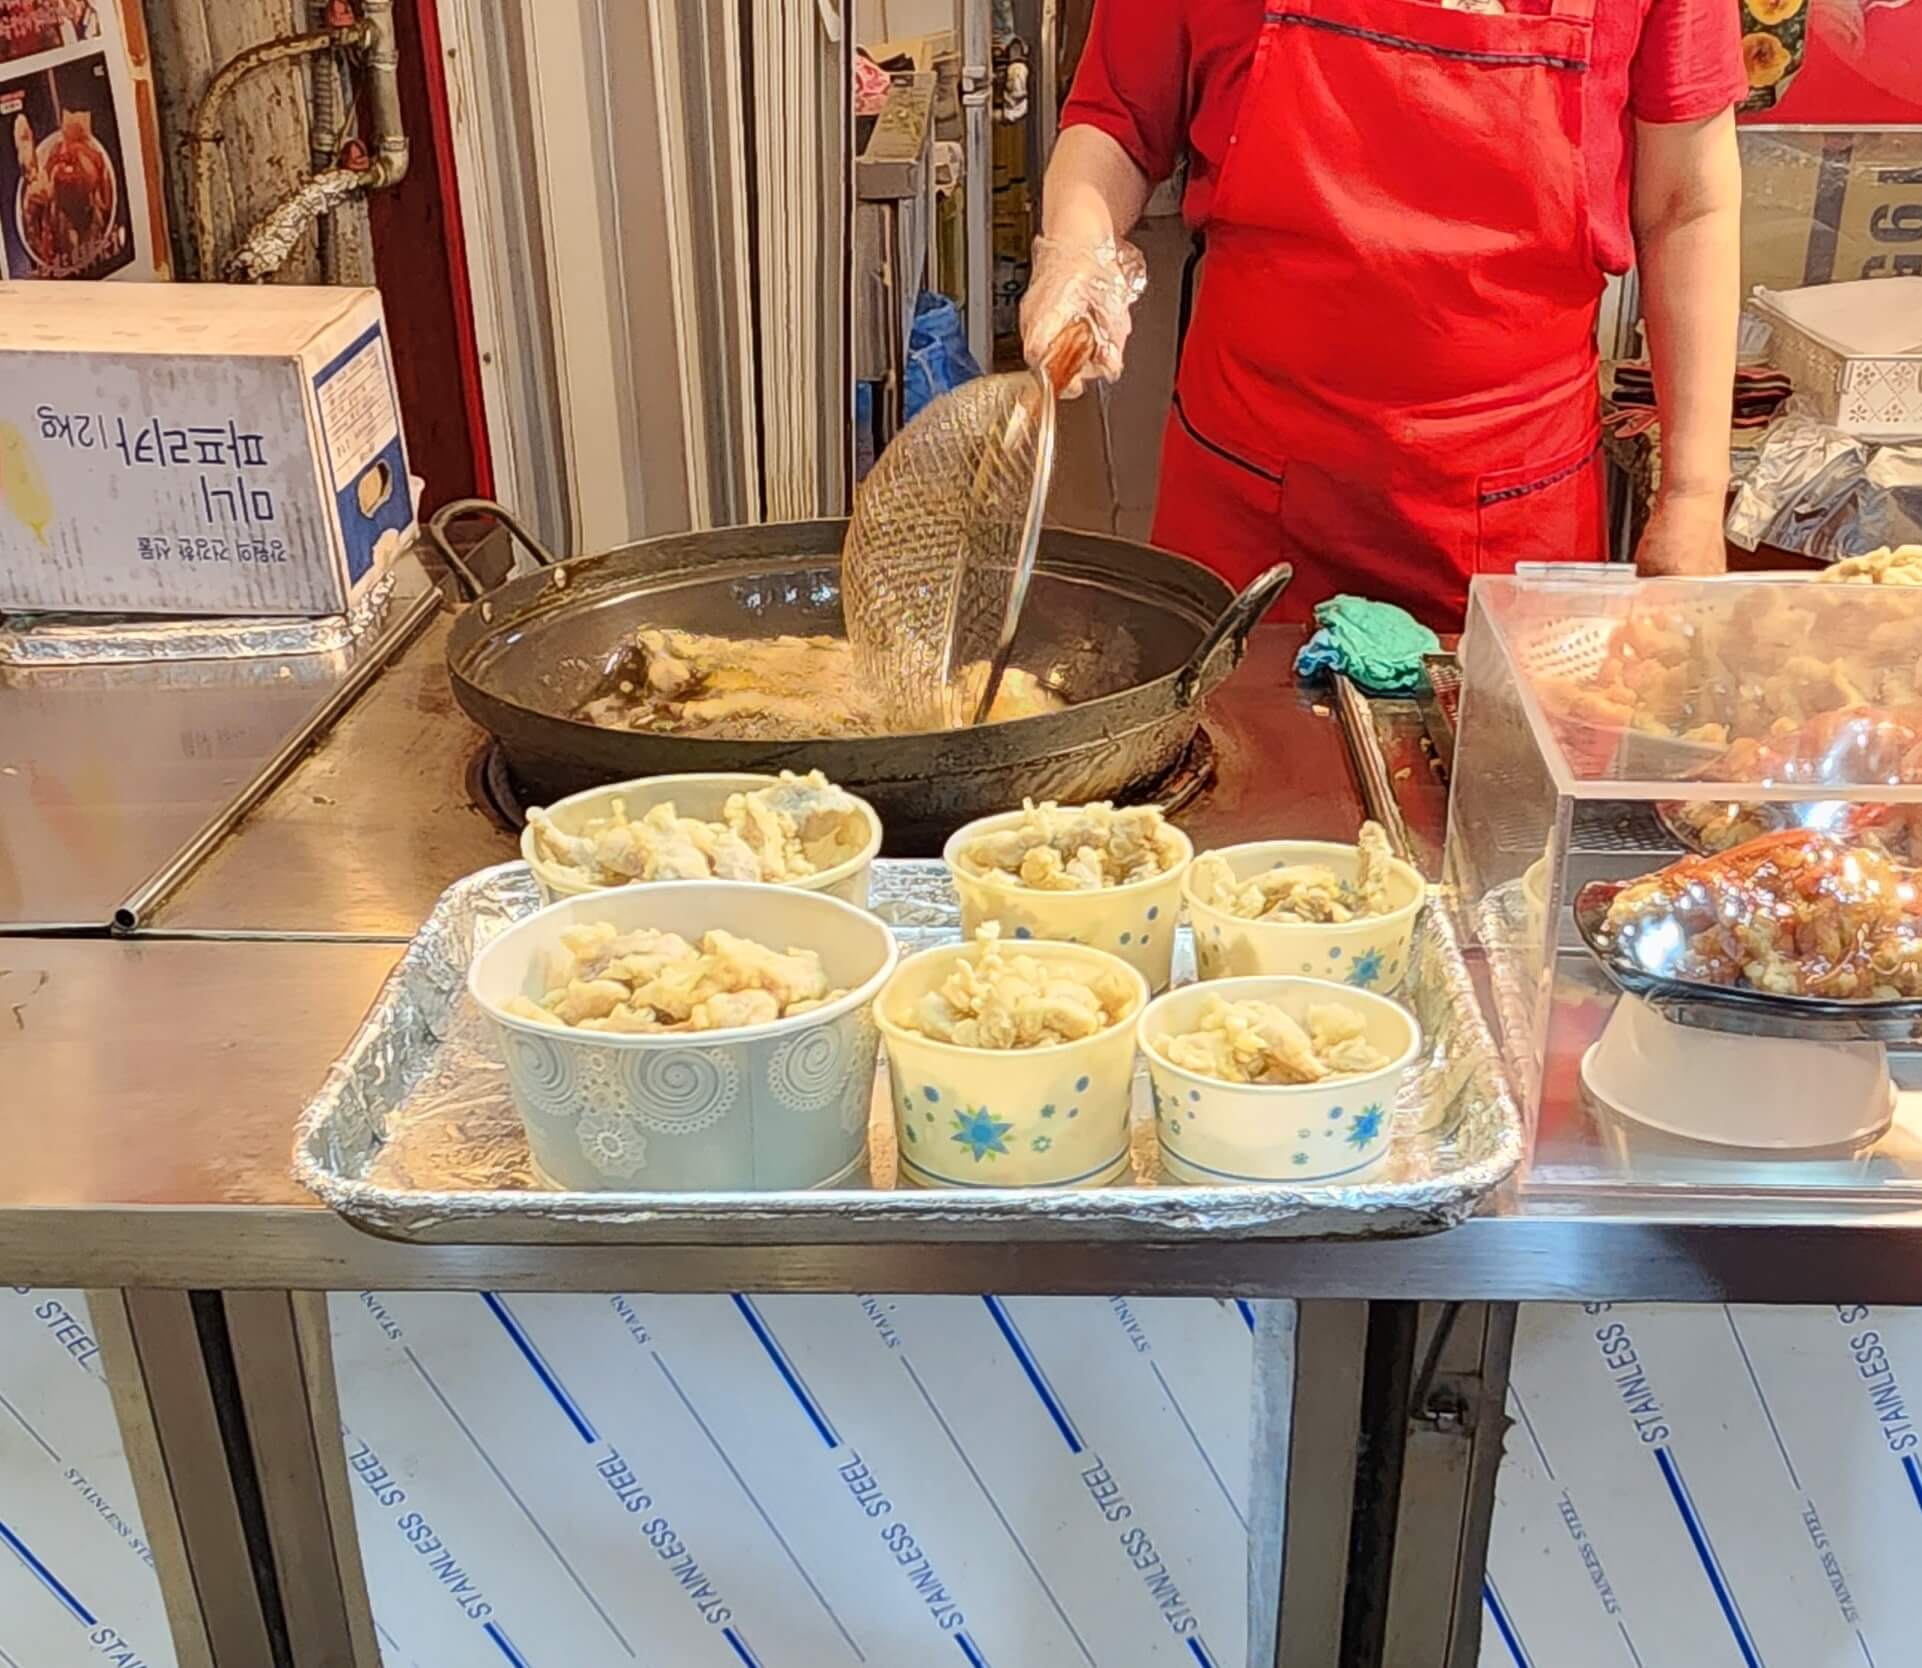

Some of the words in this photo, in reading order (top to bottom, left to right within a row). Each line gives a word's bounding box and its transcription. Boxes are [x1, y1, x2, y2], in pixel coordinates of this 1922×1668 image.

[116, 417, 268, 468] 파프리카
[201, 475, 274, 523] 미니
[138, 537, 170, 560] 선물
[179, 538, 230, 562] 건강한
[238, 539, 288, 562] 강원의
[36, 1301, 99, 1374] STEEL
[1596, 1323, 1669, 1443] STAINLESS
[1850, 1332, 1918, 1451] STAINLESS
[64, 1468, 132, 1537] STAINLESS
[349, 1438, 405, 1506] STEEL
[596, 1444, 652, 1512] STEEL
[838, 1449, 892, 1517] STEEL
[1081, 1453, 1132, 1522] STEEL
[1802, 1499, 1830, 1549] STEEL
[398, 1512, 492, 1619] STAINLESS
[642, 1518, 732, 1624] STAINLESS
[882, 1523, 964, 1630] STAINLESS
[1120, 1528, 1198, 1633] STAINLESS
